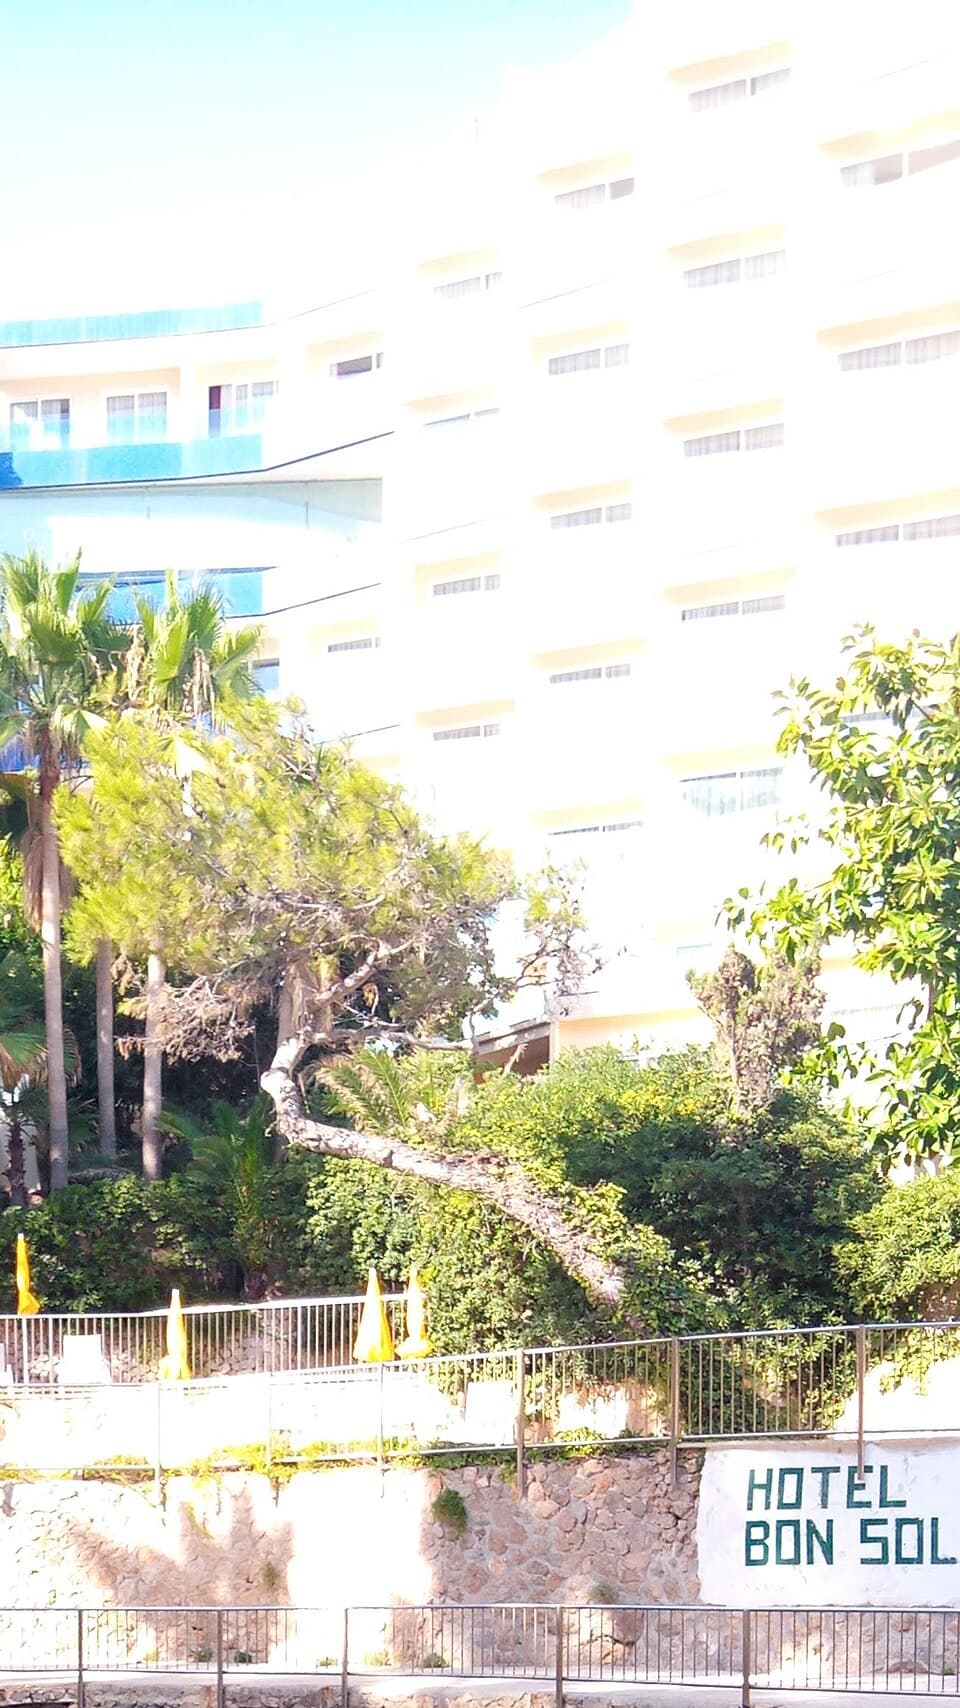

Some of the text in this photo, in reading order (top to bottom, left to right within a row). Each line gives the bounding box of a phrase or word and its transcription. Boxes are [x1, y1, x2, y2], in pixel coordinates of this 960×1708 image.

[746, 1464, 907, 1511] HOTEL
[744, 1517, 958, 1566] BON SOL
